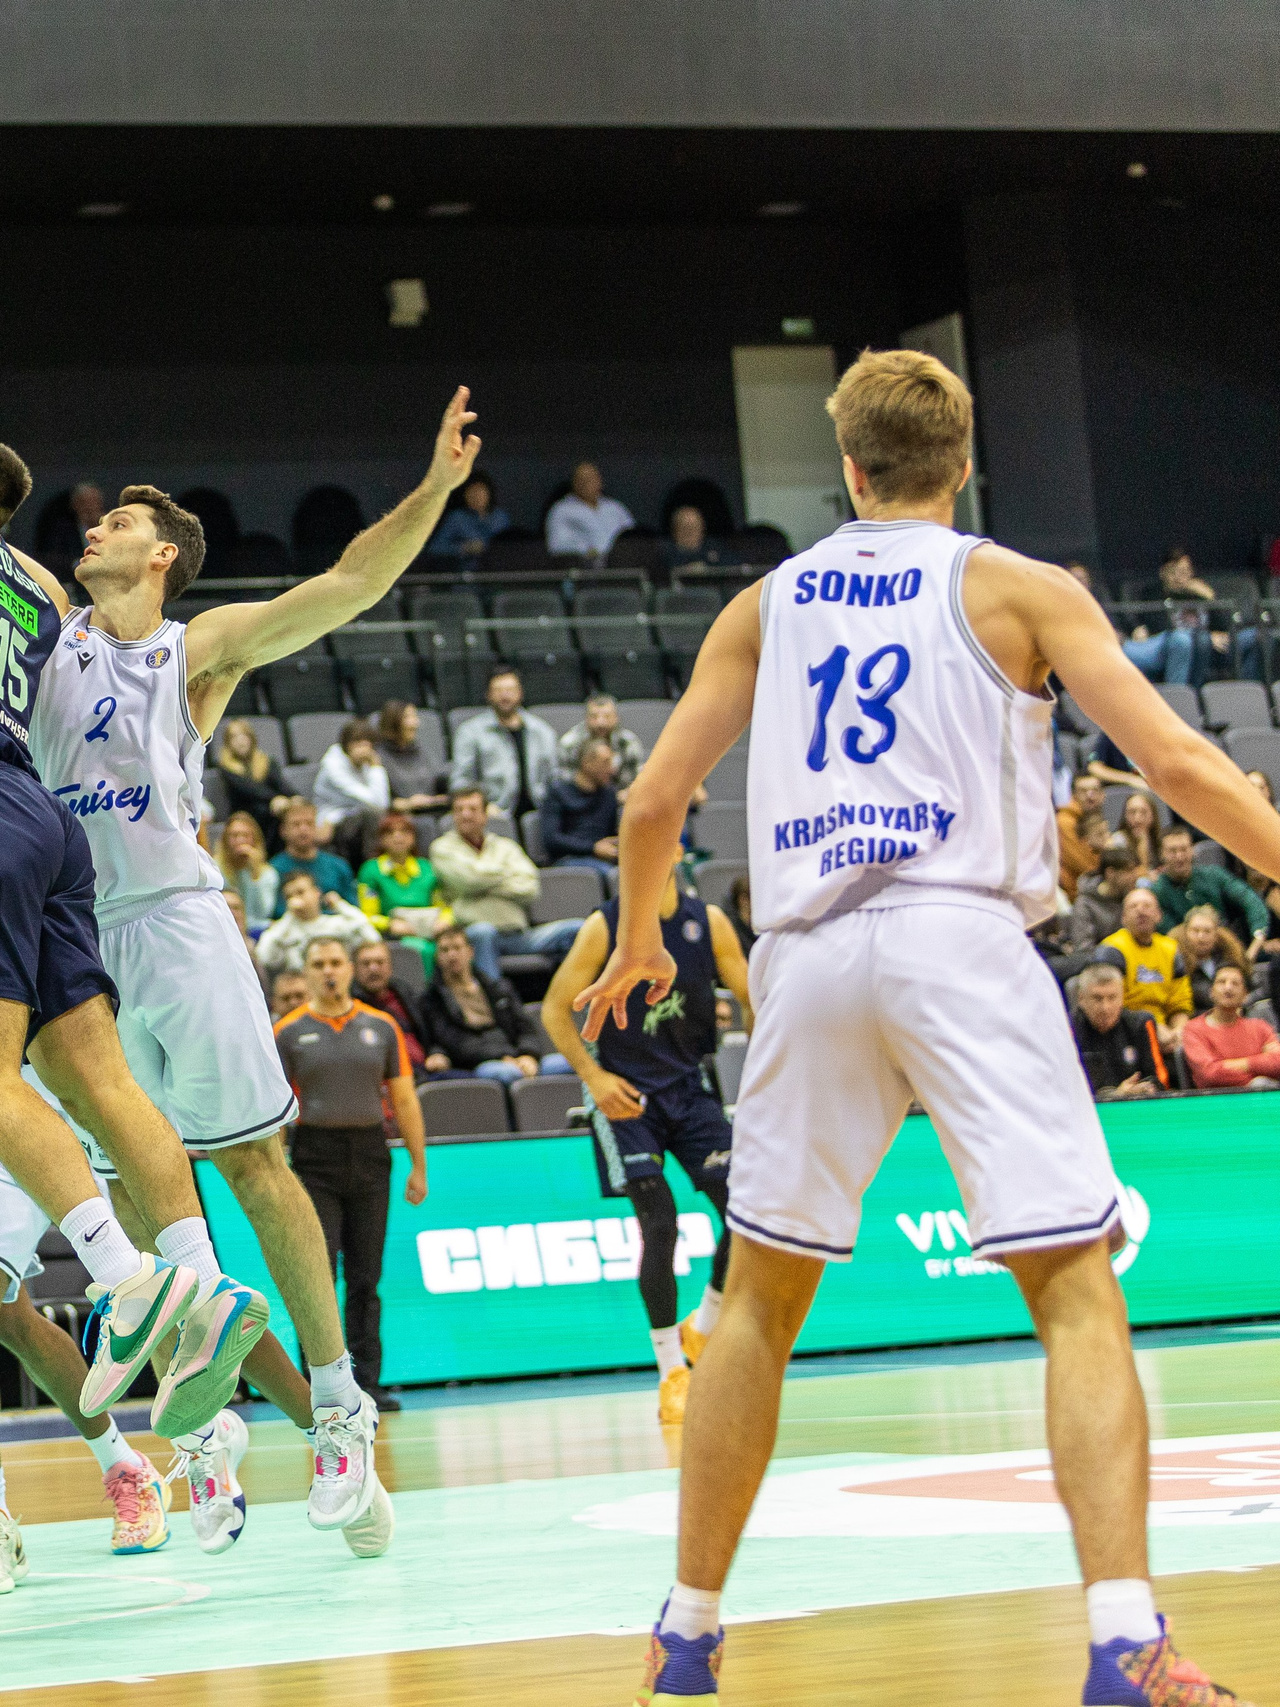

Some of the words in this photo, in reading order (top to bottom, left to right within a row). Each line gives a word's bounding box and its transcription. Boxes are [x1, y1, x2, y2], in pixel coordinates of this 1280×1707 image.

[794, 568, 922, 608] SONKO
[84, 696, 117, 742] 2
[806, 643, 910, 772] 13
[774, 801, 956, 853] KRASNOYARSK
[819, 836, 918, 878] REGION
[416, 1212, 717, 1294] СИБУР
